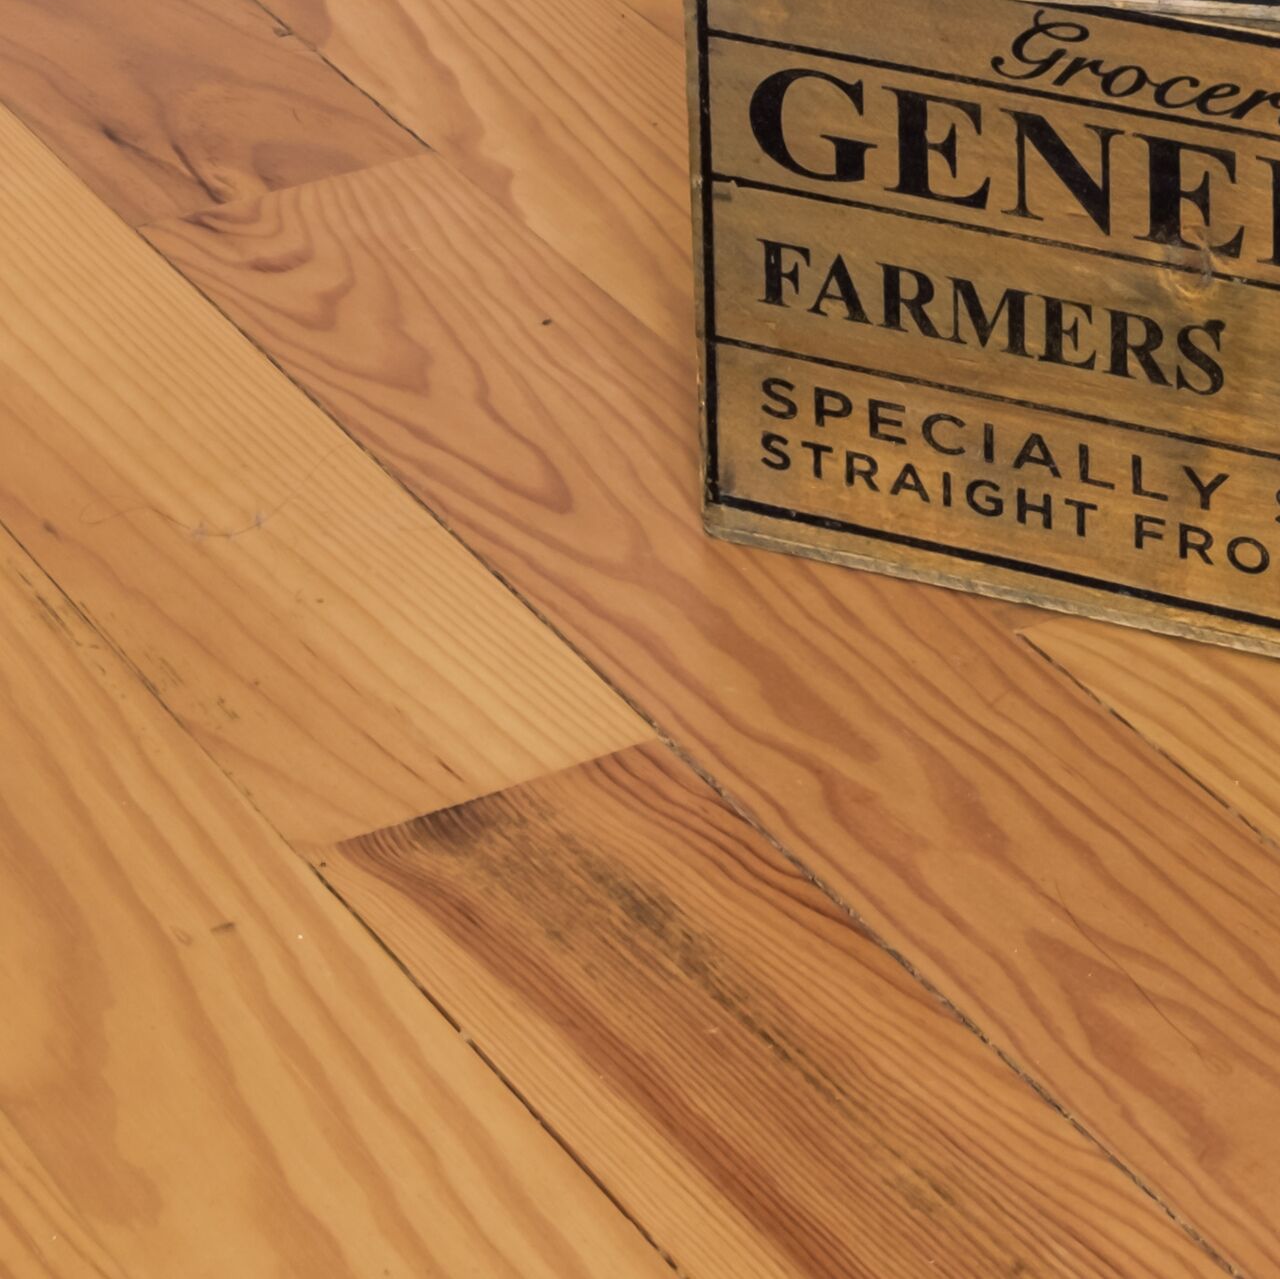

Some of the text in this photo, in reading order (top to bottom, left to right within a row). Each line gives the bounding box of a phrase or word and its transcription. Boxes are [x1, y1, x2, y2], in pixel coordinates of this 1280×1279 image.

[757, 237, 1227, 397] FARMERS
[760, 376, 1229, 510] SPECIALLY
[760, 433, 1113, 538] STRAIGHT
